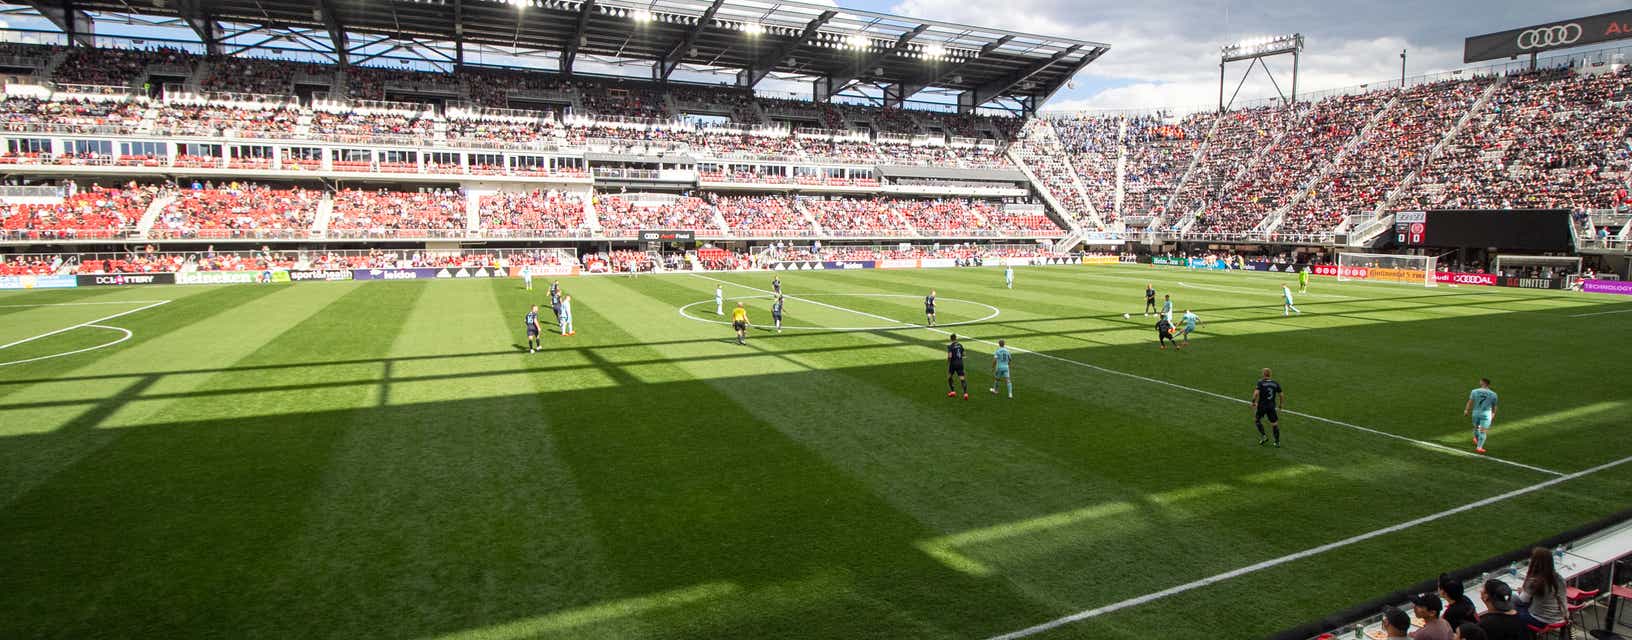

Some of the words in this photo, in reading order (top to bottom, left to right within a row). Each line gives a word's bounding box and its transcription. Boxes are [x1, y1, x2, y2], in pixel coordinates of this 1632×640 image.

[384, 270, 417, 280] leidos
[1519, 278, 1550, 288] UNITED
[1267, 387, 1273, 400] 3
[1479, 395, 1487, 406] 7
